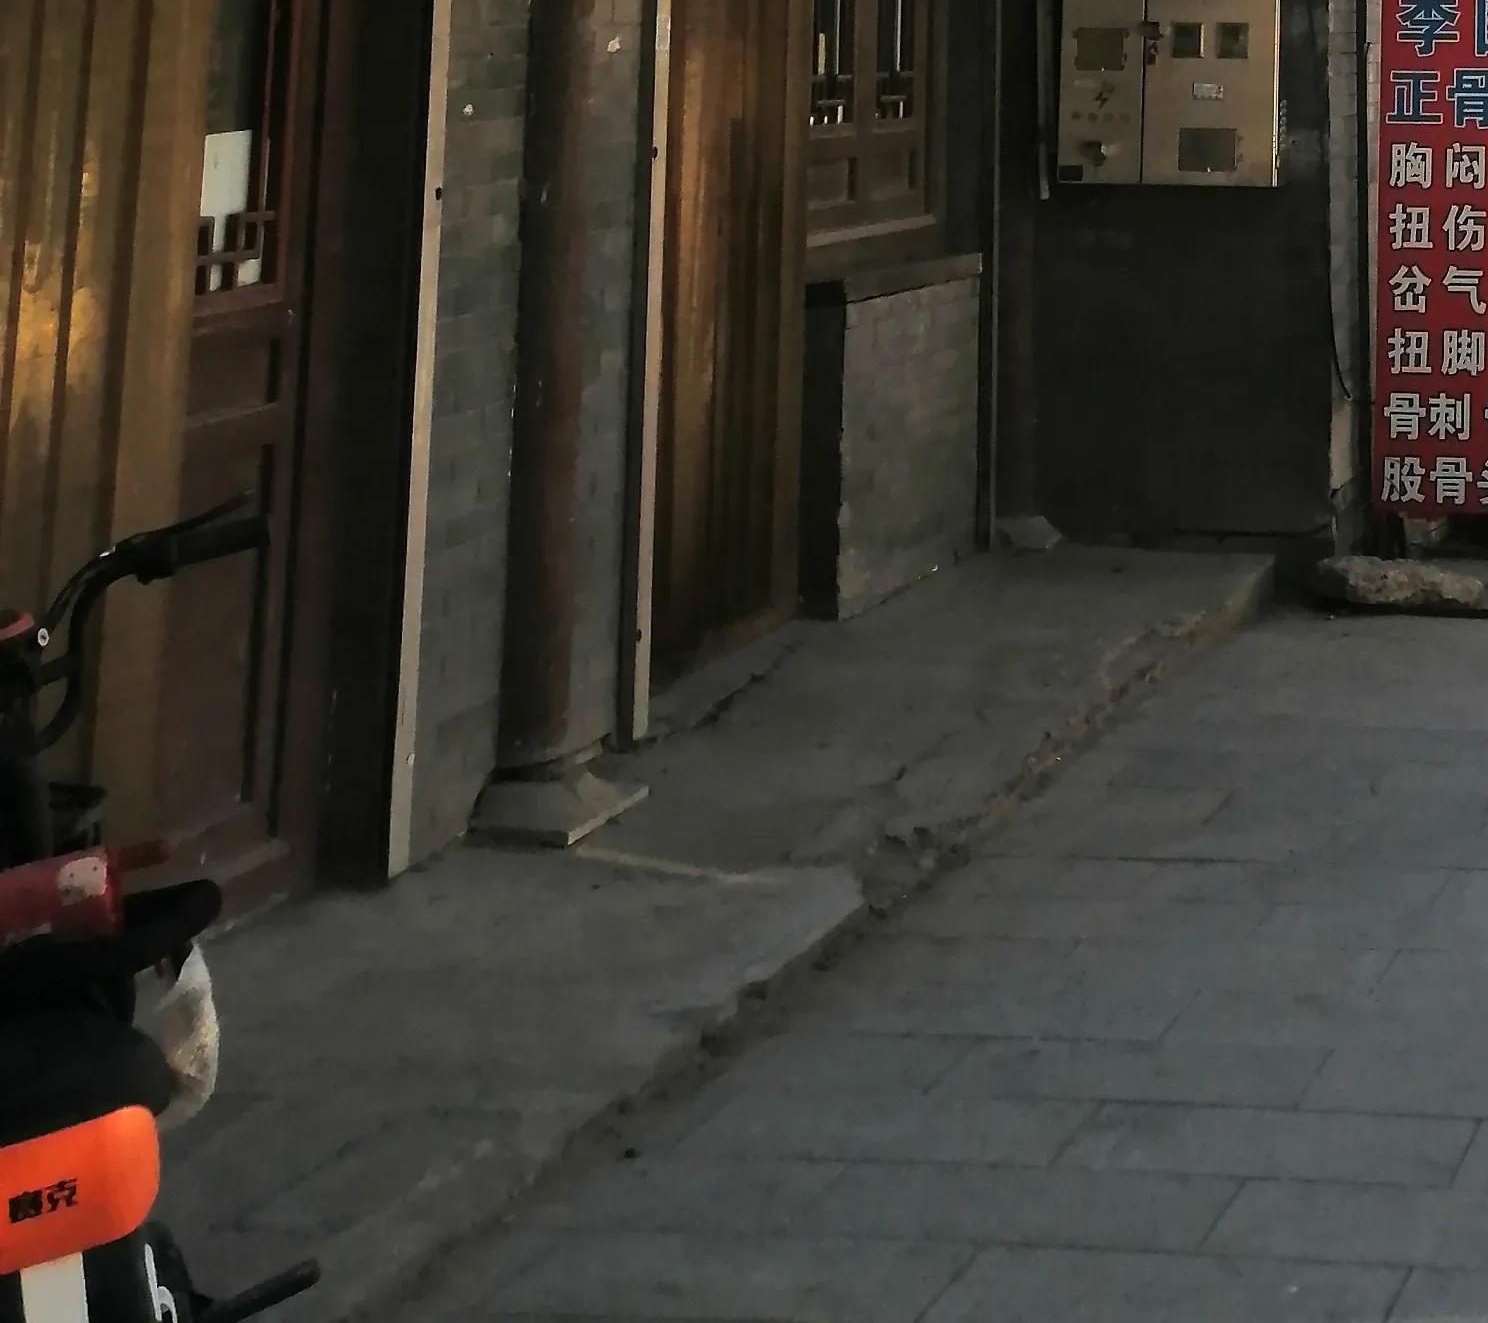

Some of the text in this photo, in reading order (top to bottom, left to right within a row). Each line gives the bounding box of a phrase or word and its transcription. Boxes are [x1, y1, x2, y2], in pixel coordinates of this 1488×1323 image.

[1389, 143, 1487, 191] 胸闷
[1389, 204, 1487, 253] 扭伤
[1388, 266, 1487, 315] 岔气
[1387, 329, 1486, 378] 扭脚
[1383, 392, 1471, 442] 骨刺
